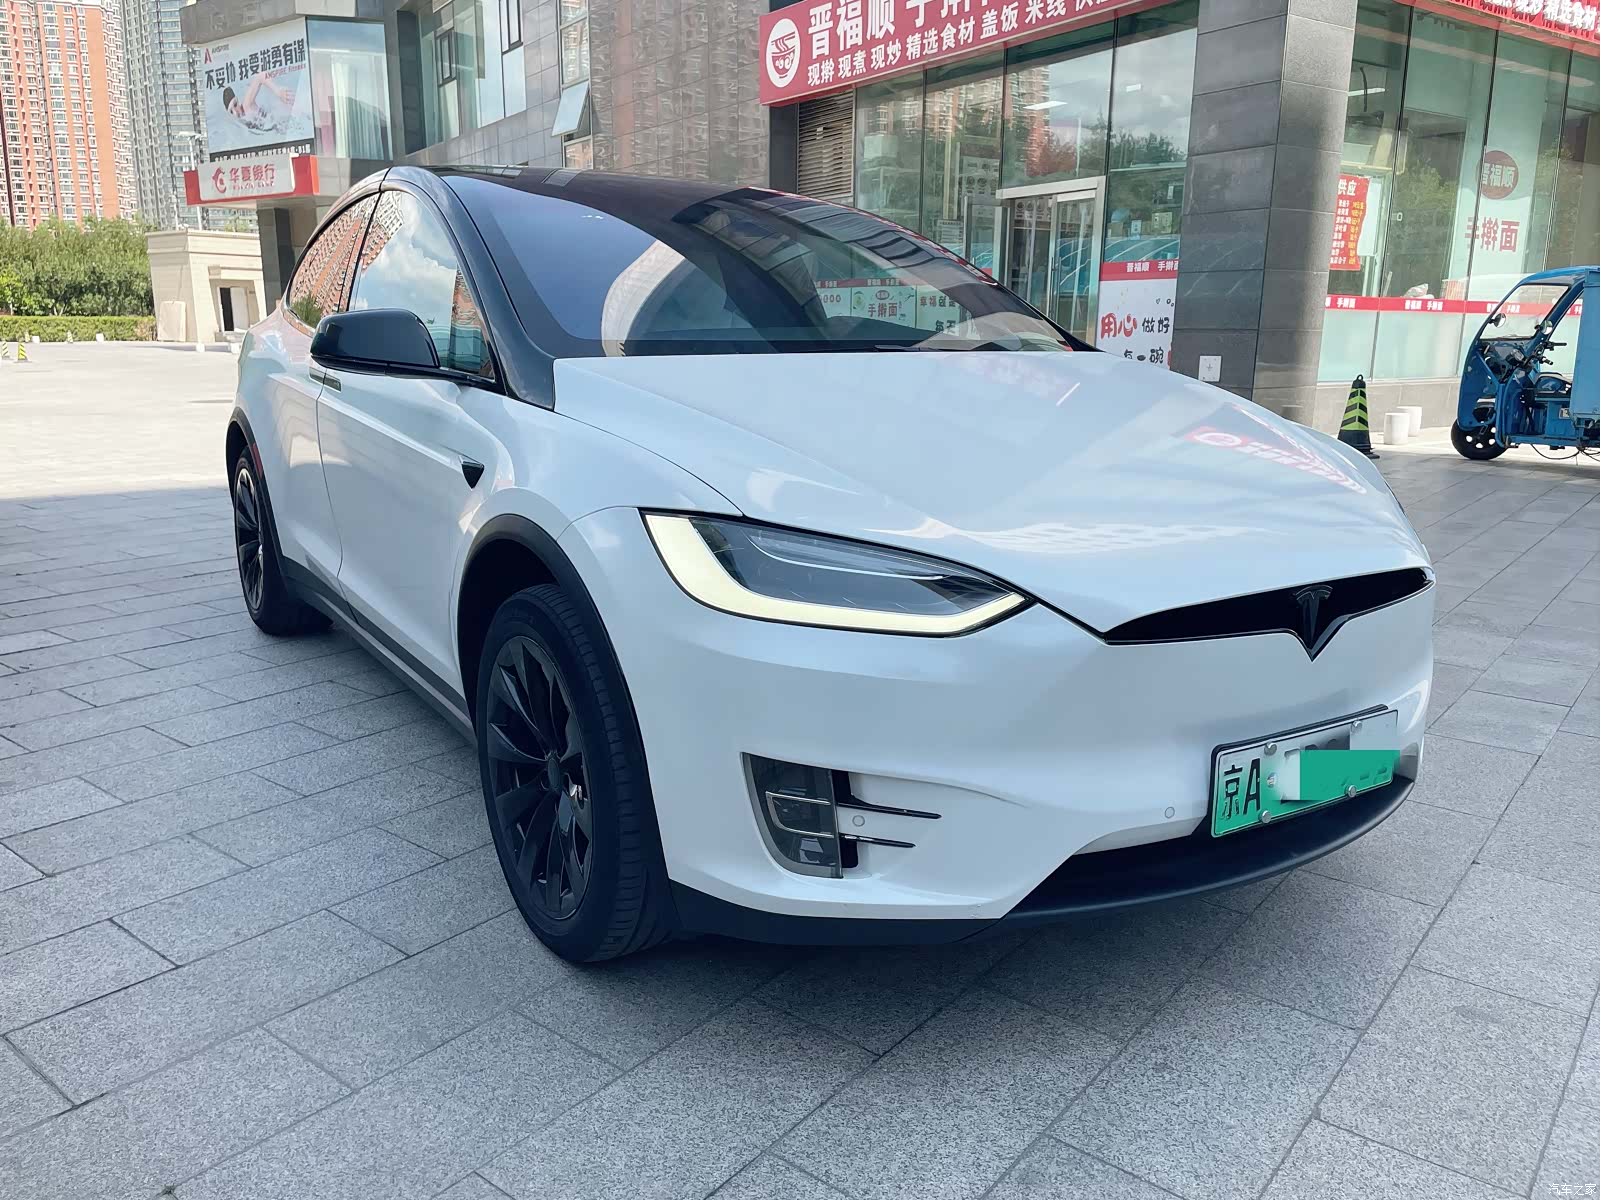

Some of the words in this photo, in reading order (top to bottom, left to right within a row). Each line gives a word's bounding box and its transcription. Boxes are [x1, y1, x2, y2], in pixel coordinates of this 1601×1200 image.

[807, 0, 896, 60] 晋福顺
[807, 61, 835, 87] 现擀
[838, 50, 867, 79] 现煮
[871, 38, 902, 70] 现炒
[906, 15, 976, 61] 精选食材
[980, 1, 1019, 40] 盖饭
[1024, 0, 1067, 25] 米线
[205, 61, 237, 90] 不妥协
[238, 38, 306, 81] 我要游勇有谋
[229, 163, 276, 184] 华夏银行
[1337, 178, 1357, 196] 供应
[1465, 216, 1521, 253] 手擀面
[1126, 261, 1150, 273] 晋福顺
[868, 302, 898, 318] 手擀面
